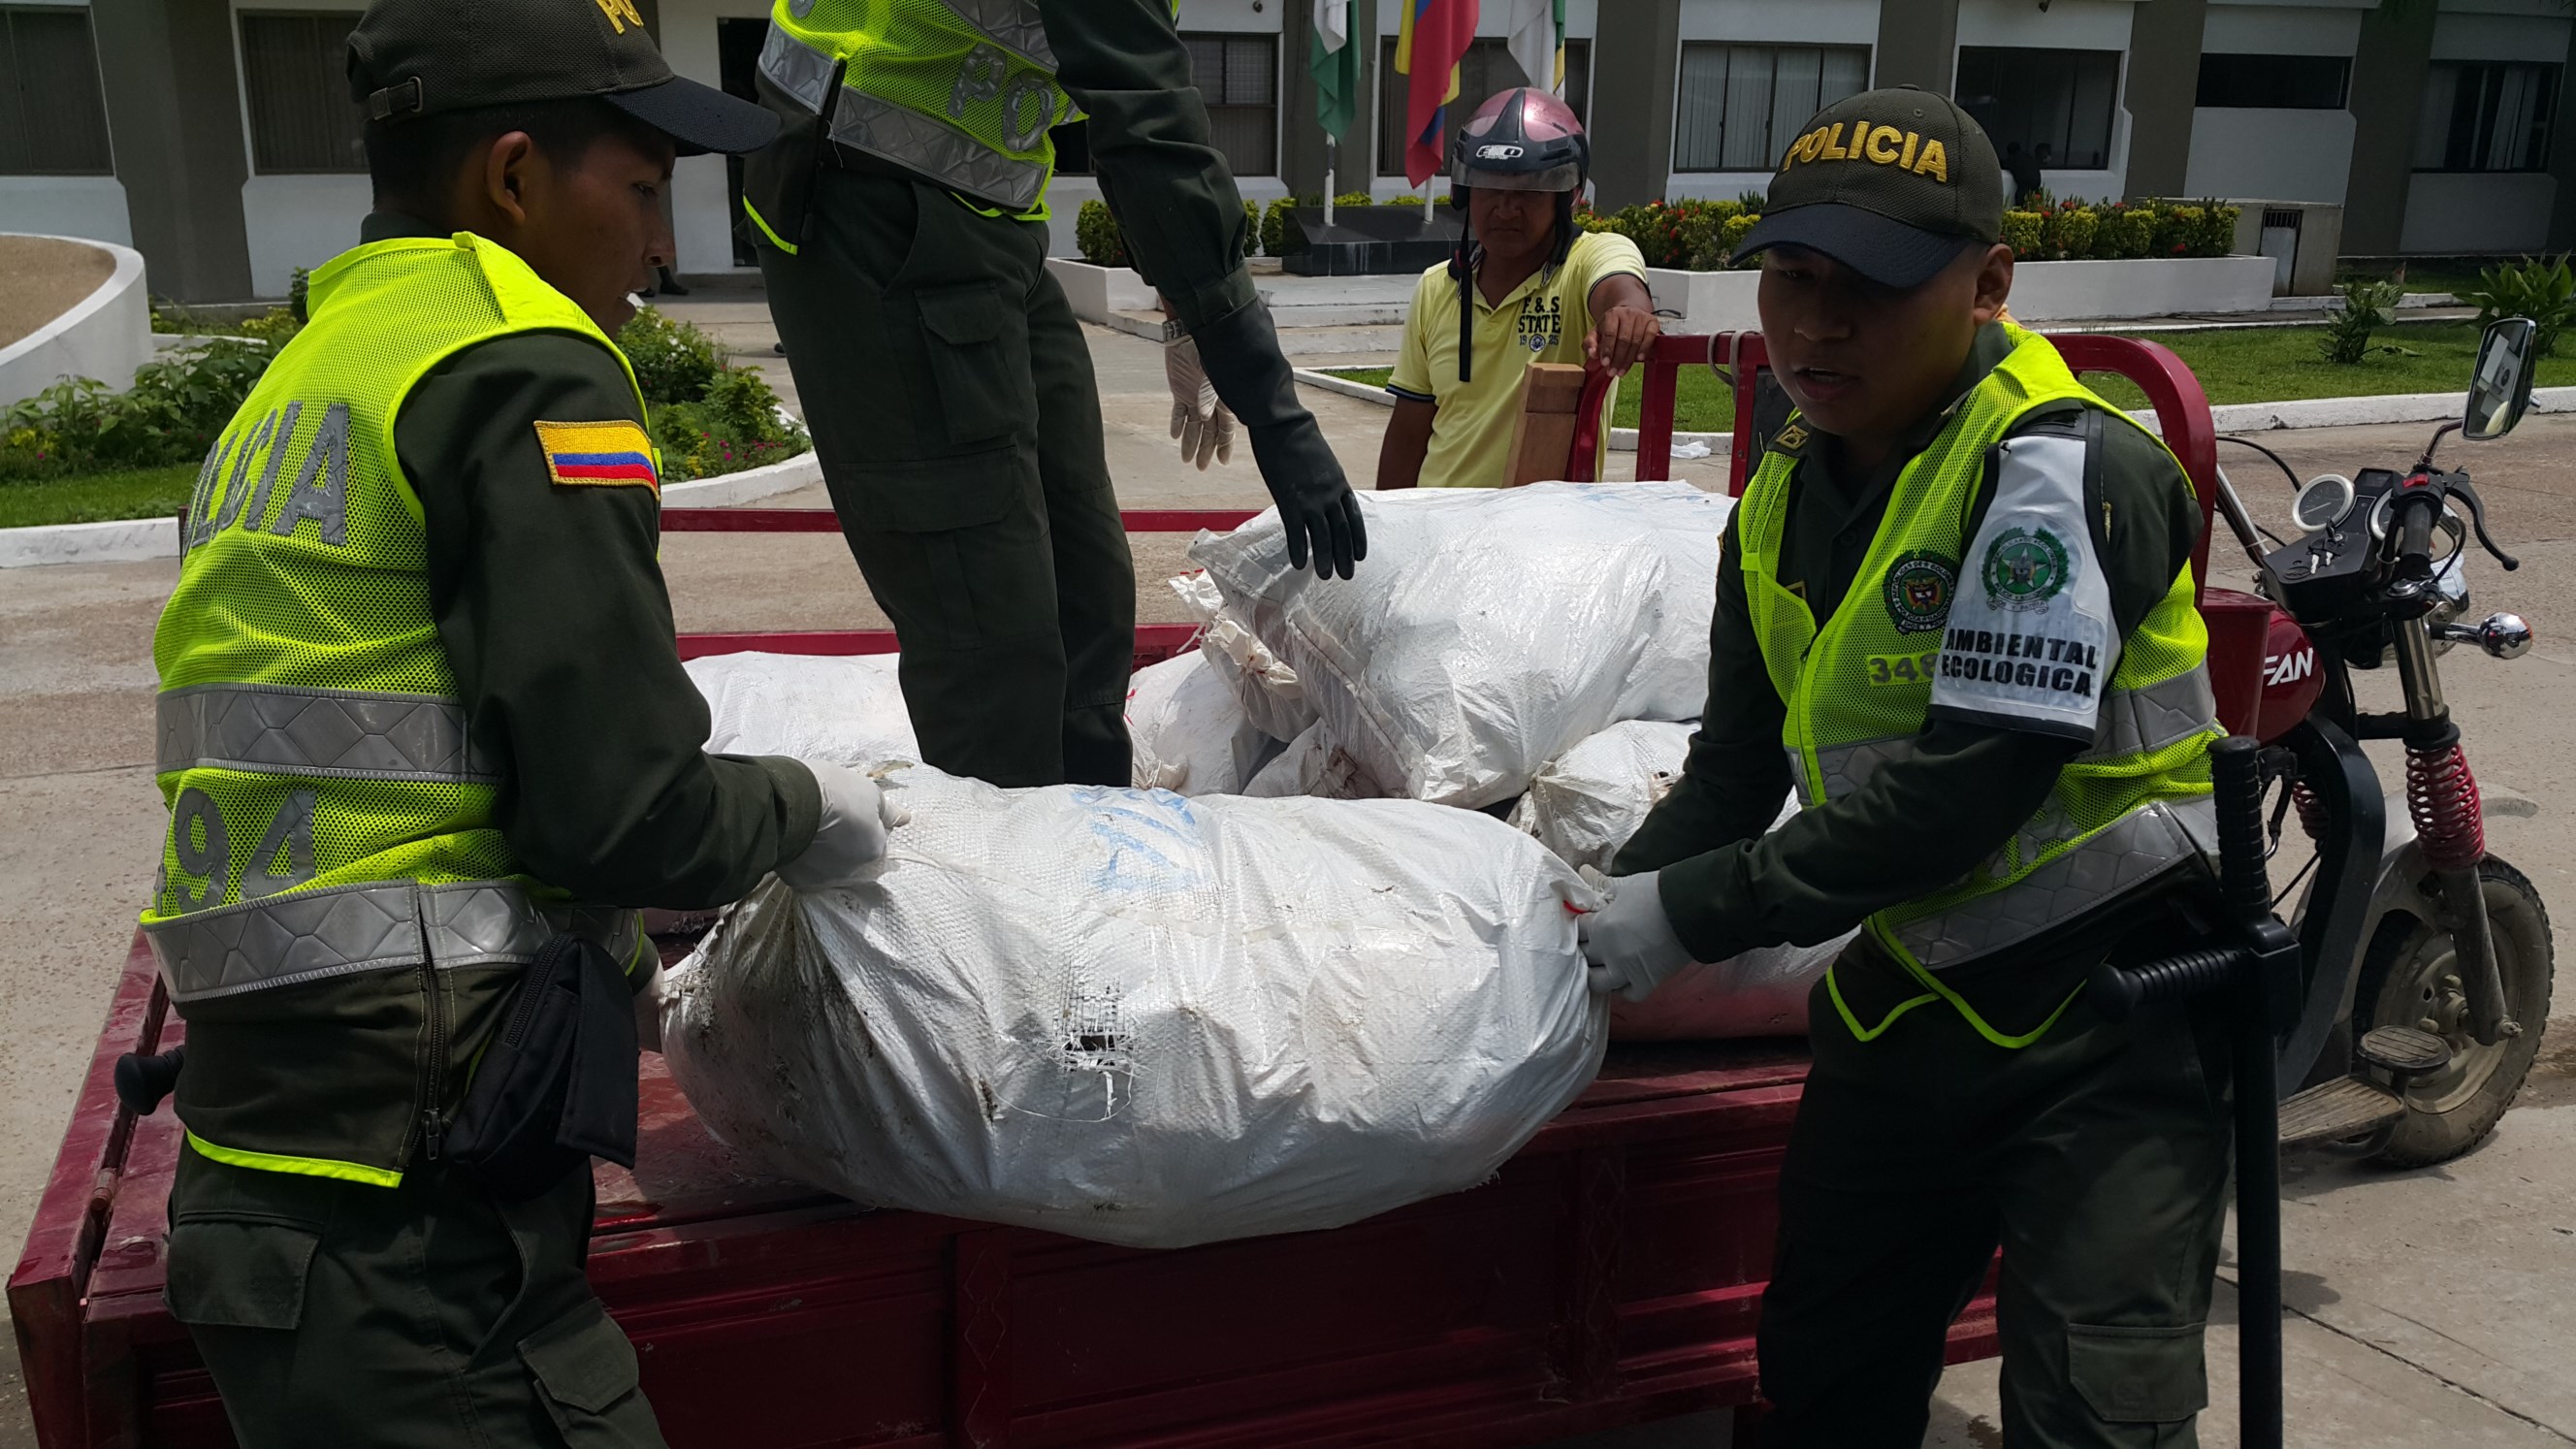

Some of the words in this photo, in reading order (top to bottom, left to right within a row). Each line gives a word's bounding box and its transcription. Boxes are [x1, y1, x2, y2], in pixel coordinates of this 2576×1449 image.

[947, 41, 1073, 152] PO
[1783, 121, 1948, 183] POLICIA
[1518, 314, 1562, 334] STATE
[183, 401, 350, 557] OLICIA
[1941, 654, 2092, 697] ECOLOGICA
[1945, 628, 2098, 670] AMBIENTAL
[154, 787, 318, 918] 94
